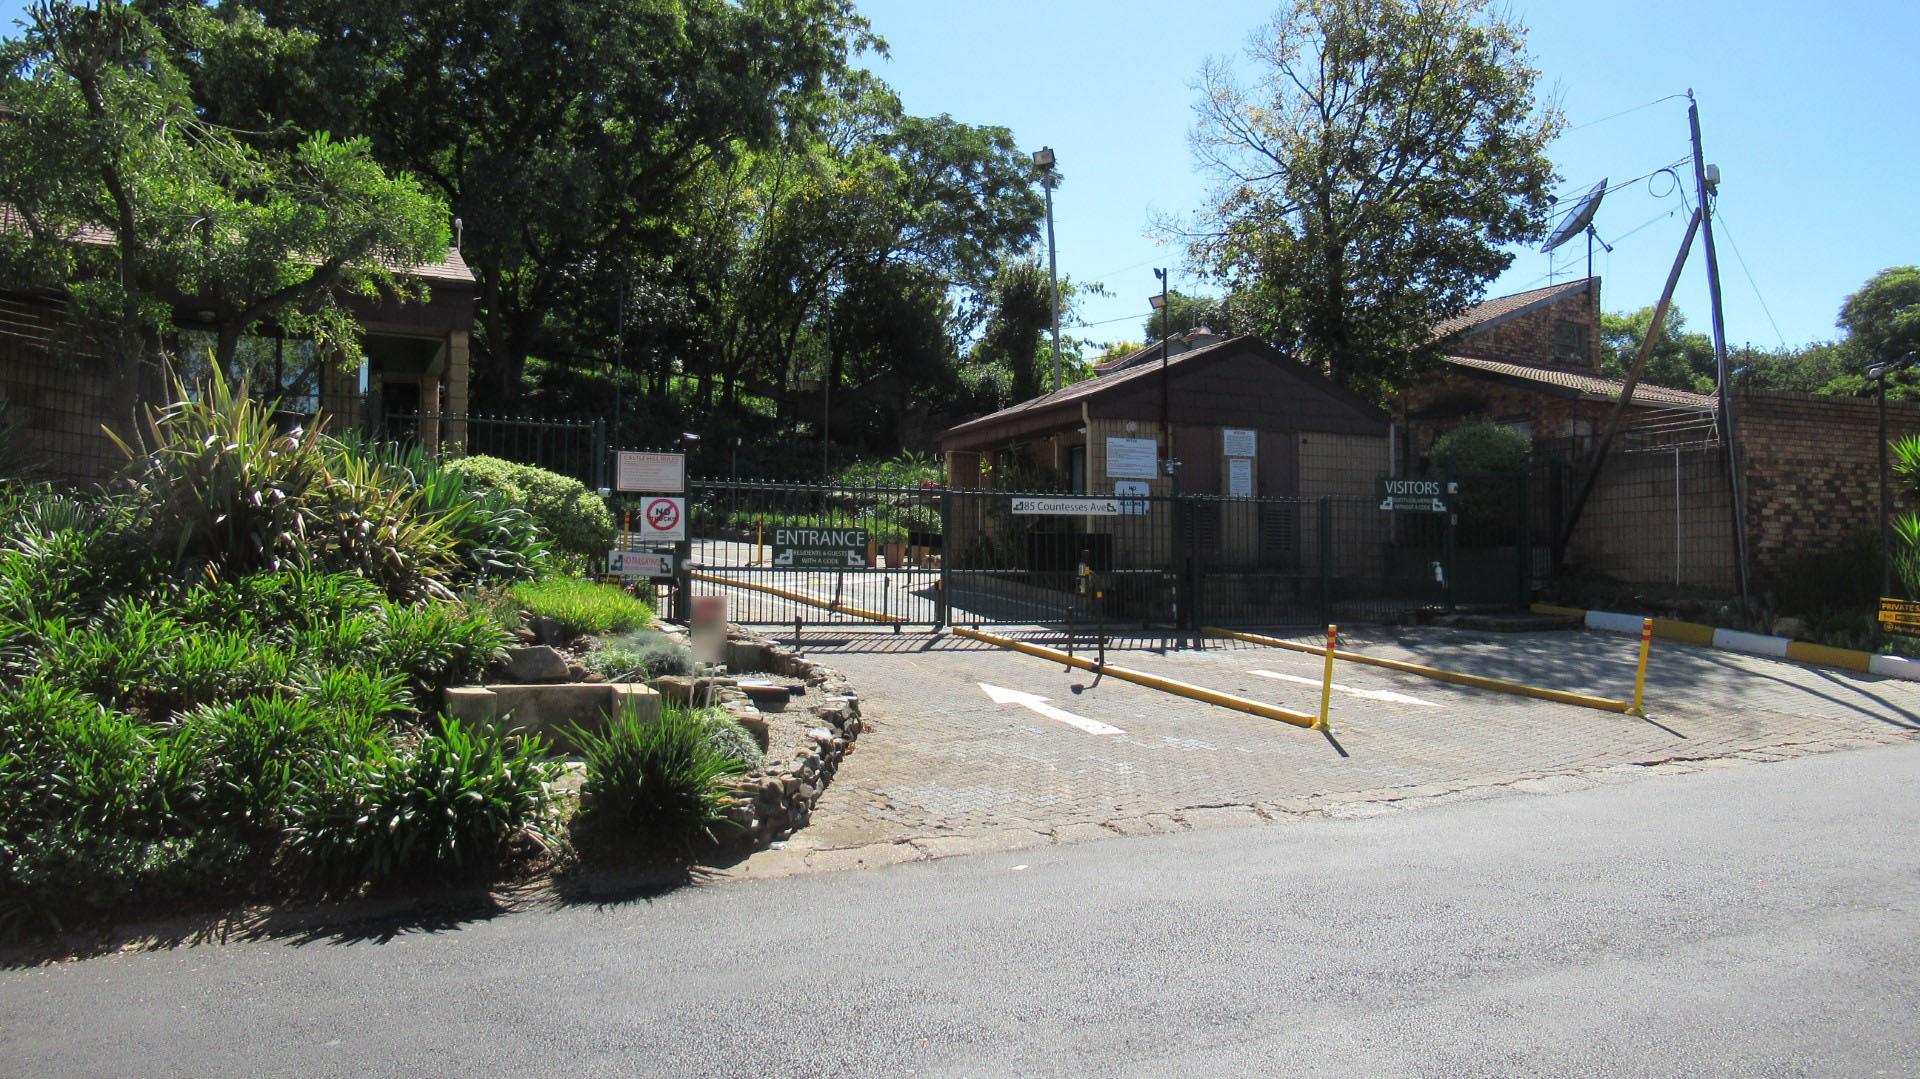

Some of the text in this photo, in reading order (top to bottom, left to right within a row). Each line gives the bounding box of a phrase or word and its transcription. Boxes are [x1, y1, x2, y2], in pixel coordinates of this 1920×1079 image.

[1385, 481, 1440, 495] VISITORS
[655, 508, 671, 516] NO
[1037, 501, 1088, 512] Countesses
[1090, 503, 1107, 512] Ave
[776, 529, 865, 546] ENTRANCE
[1881, 603, 1914, 612] PRIVATE
